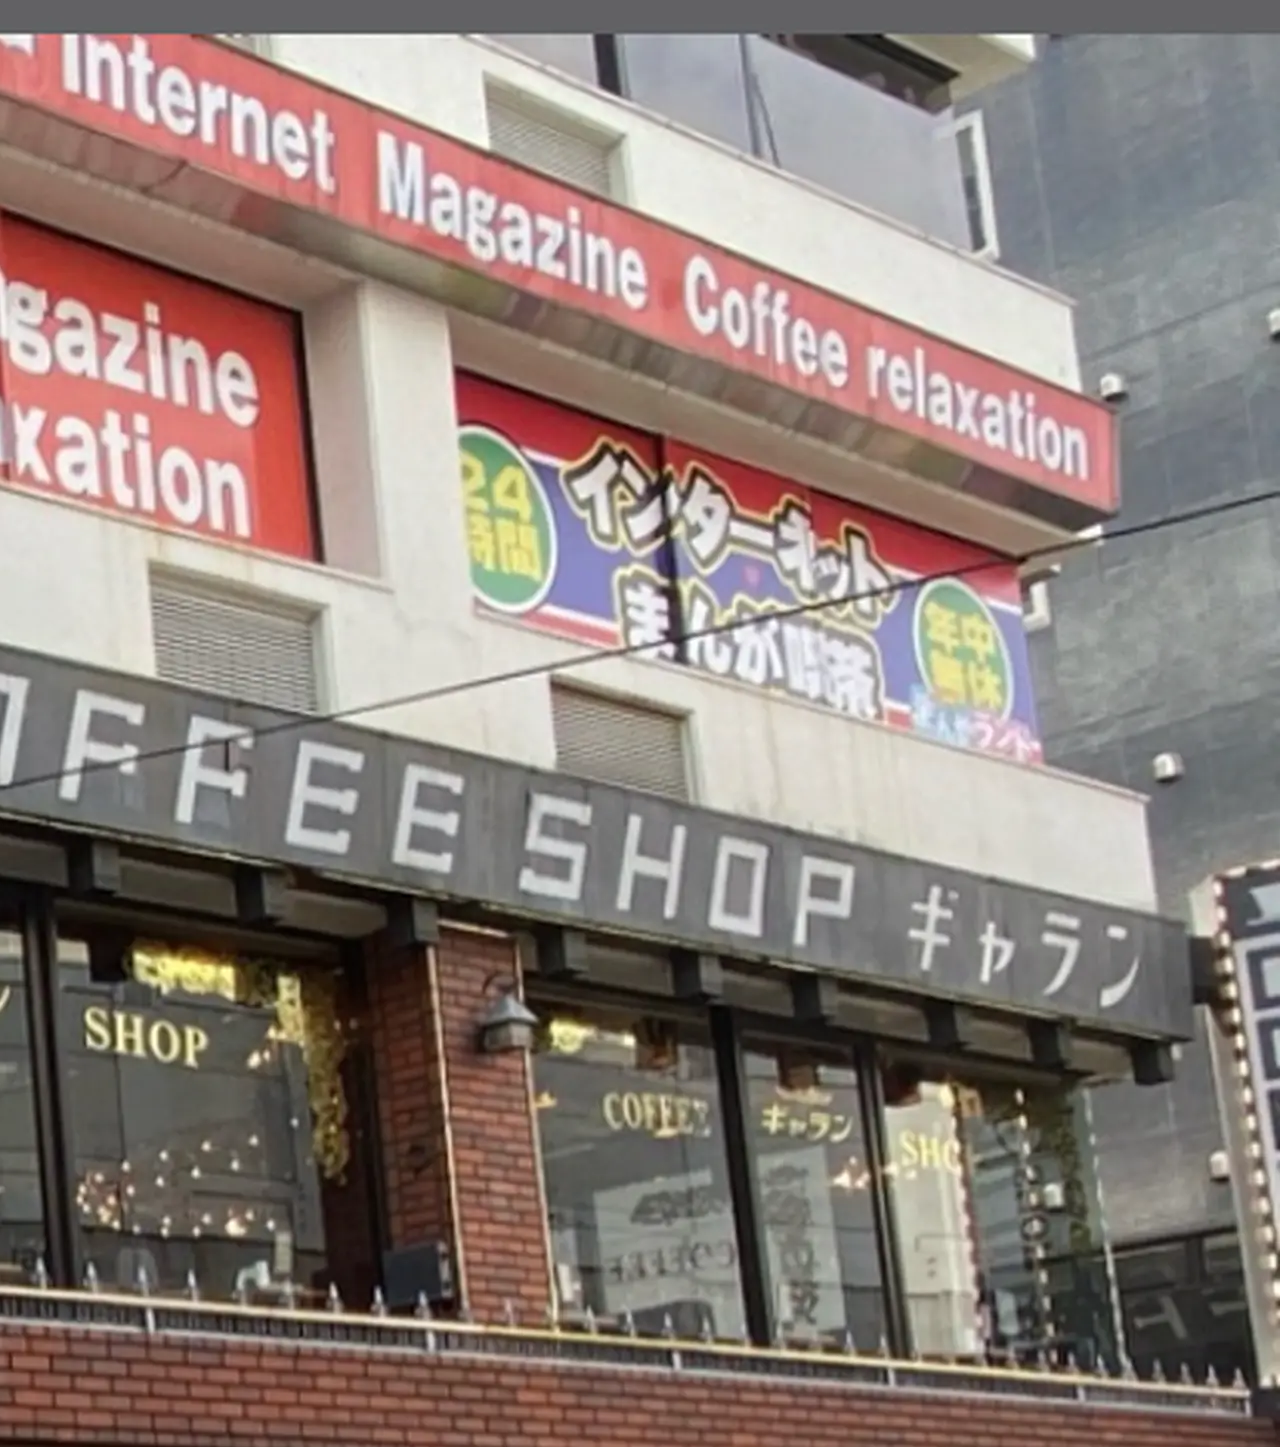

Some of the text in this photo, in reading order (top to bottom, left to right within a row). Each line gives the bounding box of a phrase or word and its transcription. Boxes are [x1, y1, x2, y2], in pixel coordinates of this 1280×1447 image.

[61, 34, 1091, 483] Internet Magazine Coffee relaxation
[459, 445, 532, 524] 24
[562, 442, 895, 625] インターネット
[624, 572, 880, 722] まんが喫茶
[518, 794, 855, 948] SHOP
[907, 884, 1141, 1008] ギャラン
[83, 1004, 210, 1068] SHOP
